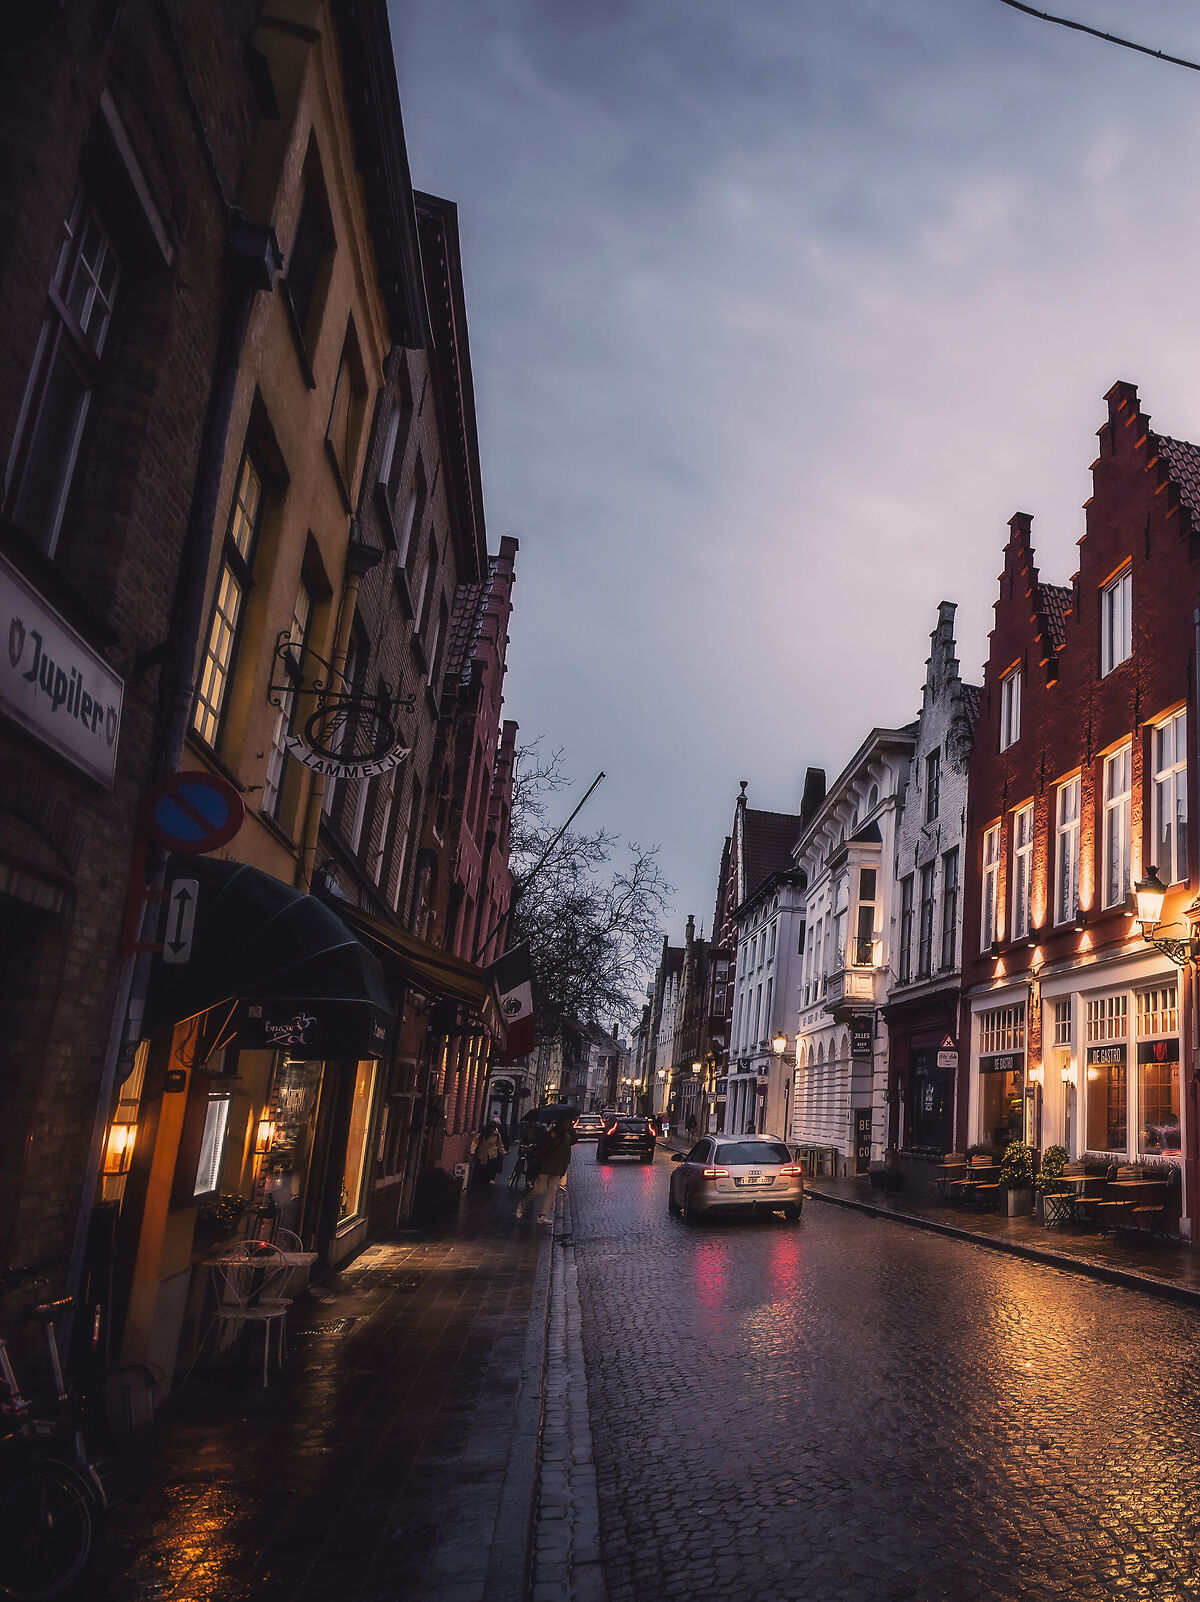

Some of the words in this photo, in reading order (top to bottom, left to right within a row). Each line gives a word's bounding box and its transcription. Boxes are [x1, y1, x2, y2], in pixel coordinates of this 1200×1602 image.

[22, 630, 104, 734] Jupiler
[302, 748, 407, 778] LAMMETJE
[1092, 1050, 1099, 1064] DE
[1100, 1047, 1120, 1064] GASTRO
